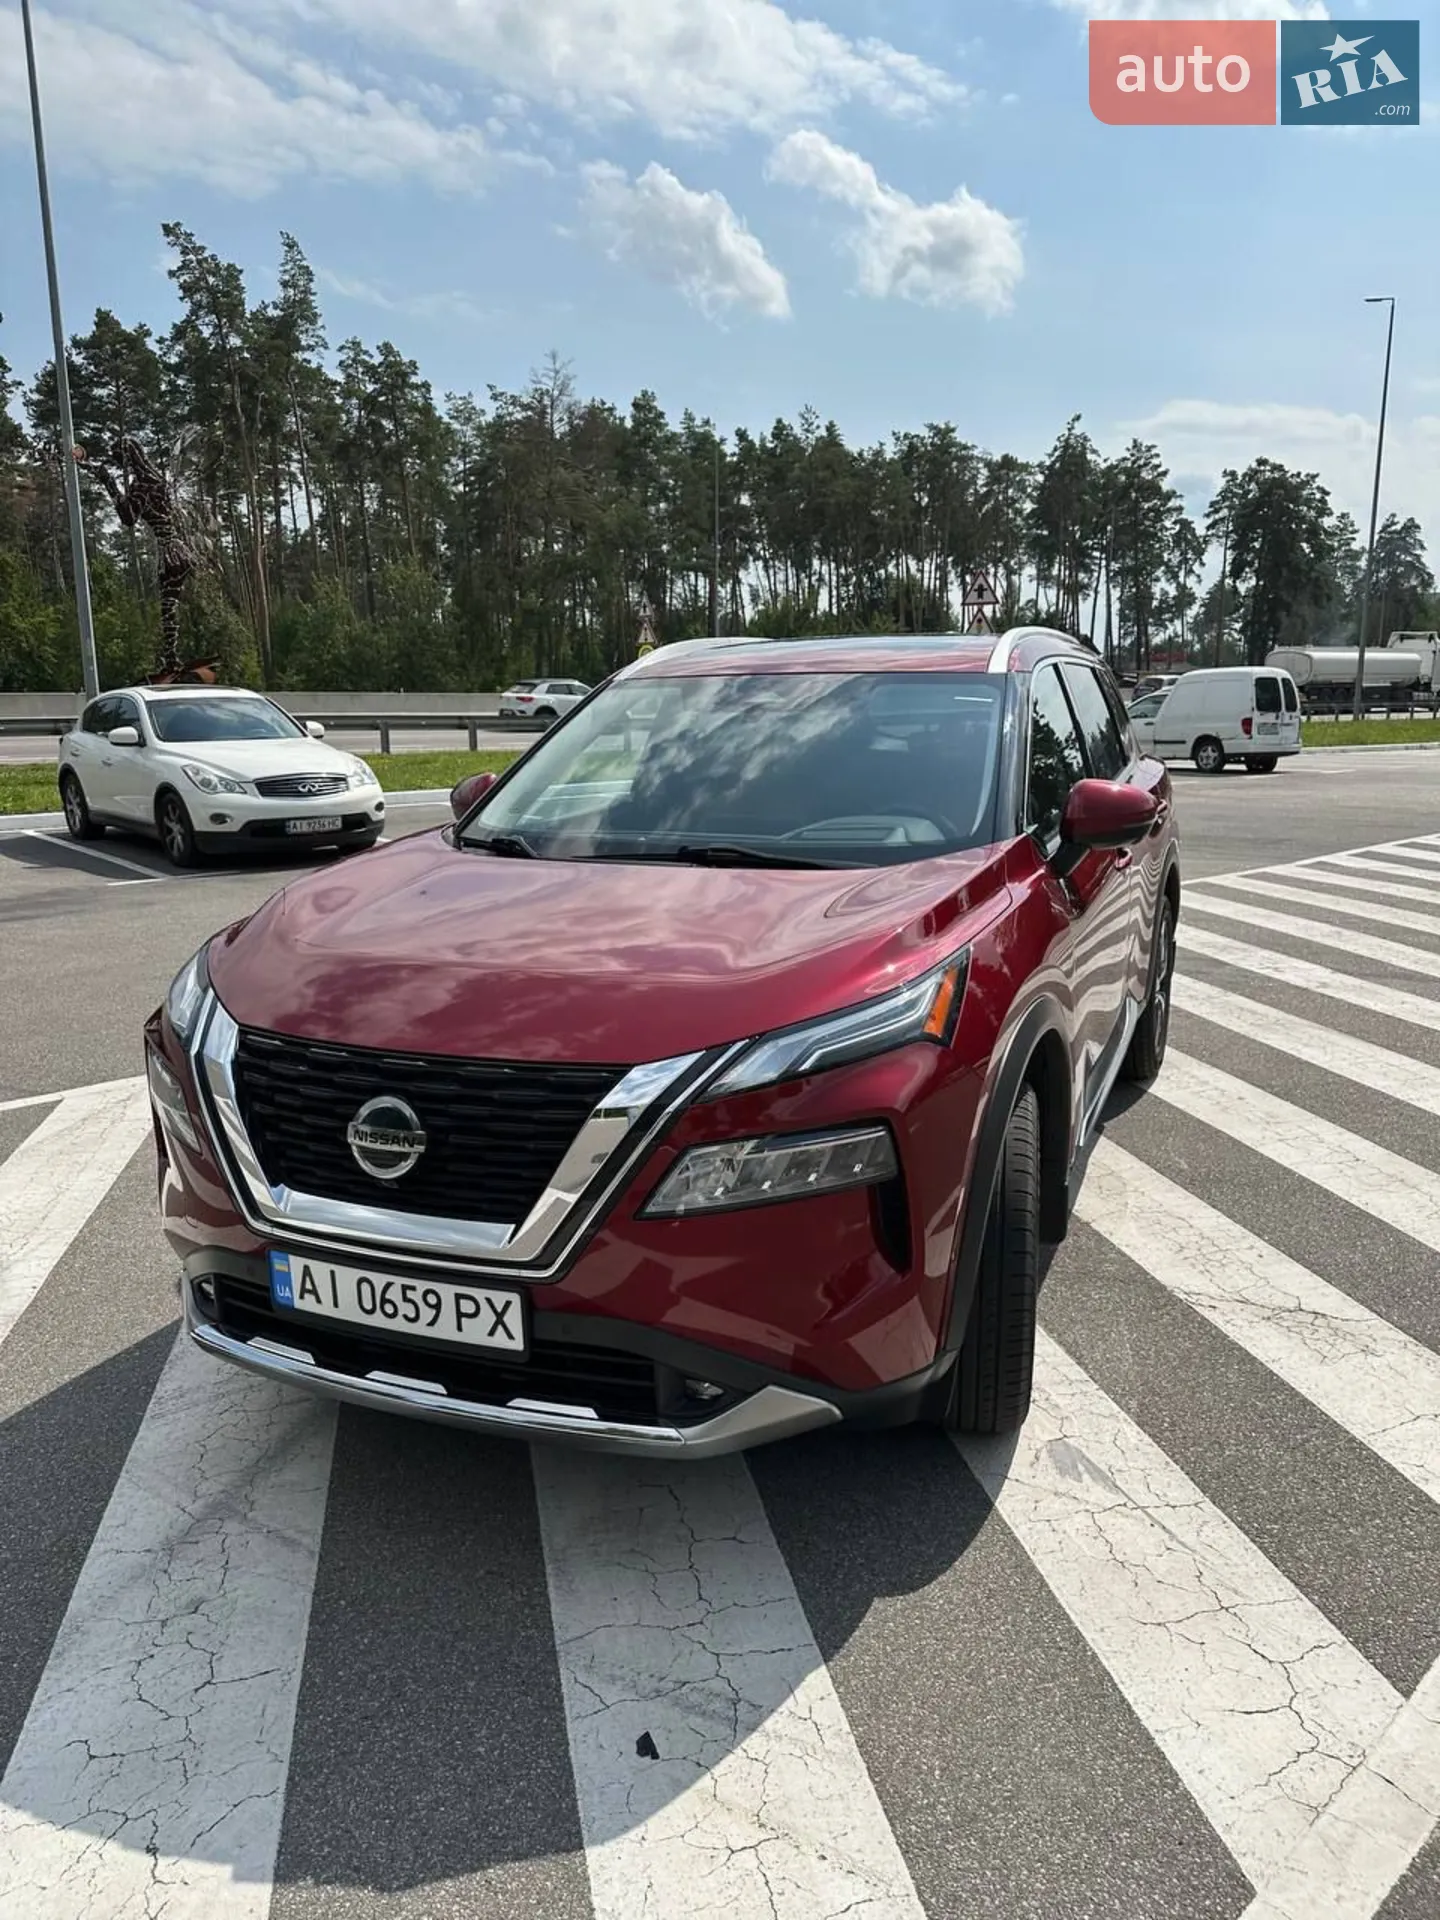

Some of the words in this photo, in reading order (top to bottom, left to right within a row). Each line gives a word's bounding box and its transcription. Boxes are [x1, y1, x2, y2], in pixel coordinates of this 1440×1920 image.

[292, 821, 303, 831] AI
[353, 1129, 416, 1148] NISSAN
[276, 1283, 292, 1298] UA
[298, 1263, 339, 1309] AI
[356, 1276, 442, 1327] 0659
[454, 1292, 515, 1341] PX
